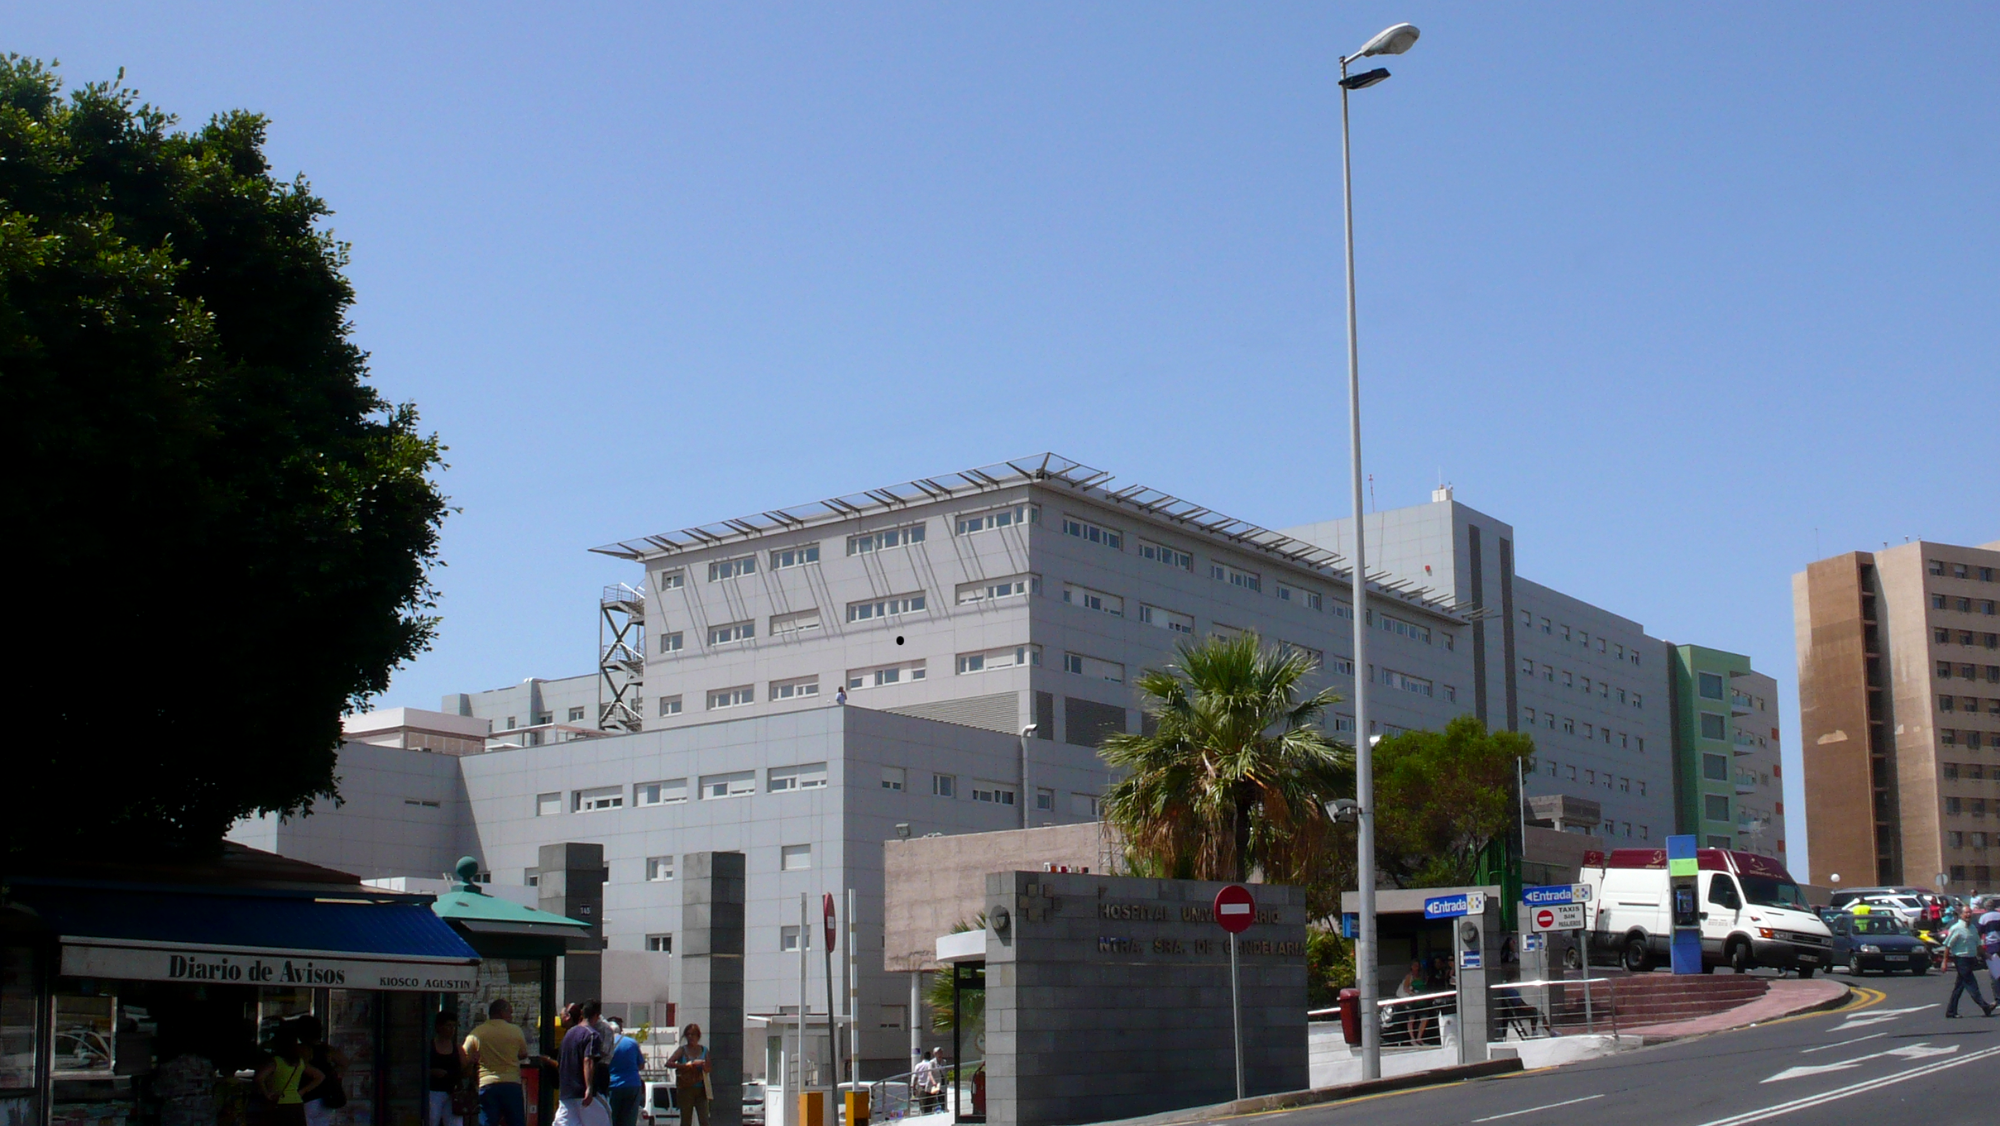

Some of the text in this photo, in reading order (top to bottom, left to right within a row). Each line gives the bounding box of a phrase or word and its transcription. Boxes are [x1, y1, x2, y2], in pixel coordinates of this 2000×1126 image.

[1533, 889, 1572, 902] Entrada
[1098, 903, 1171, 921] HOSPITAL
[1433, 899, 1467, 914] Entrada
[1195, 939, 1213, 955] DE
[168, 954, 345, 984] Diario de Avisos
[379, 976, 470, 989] KIOSCO AGUSTIN
